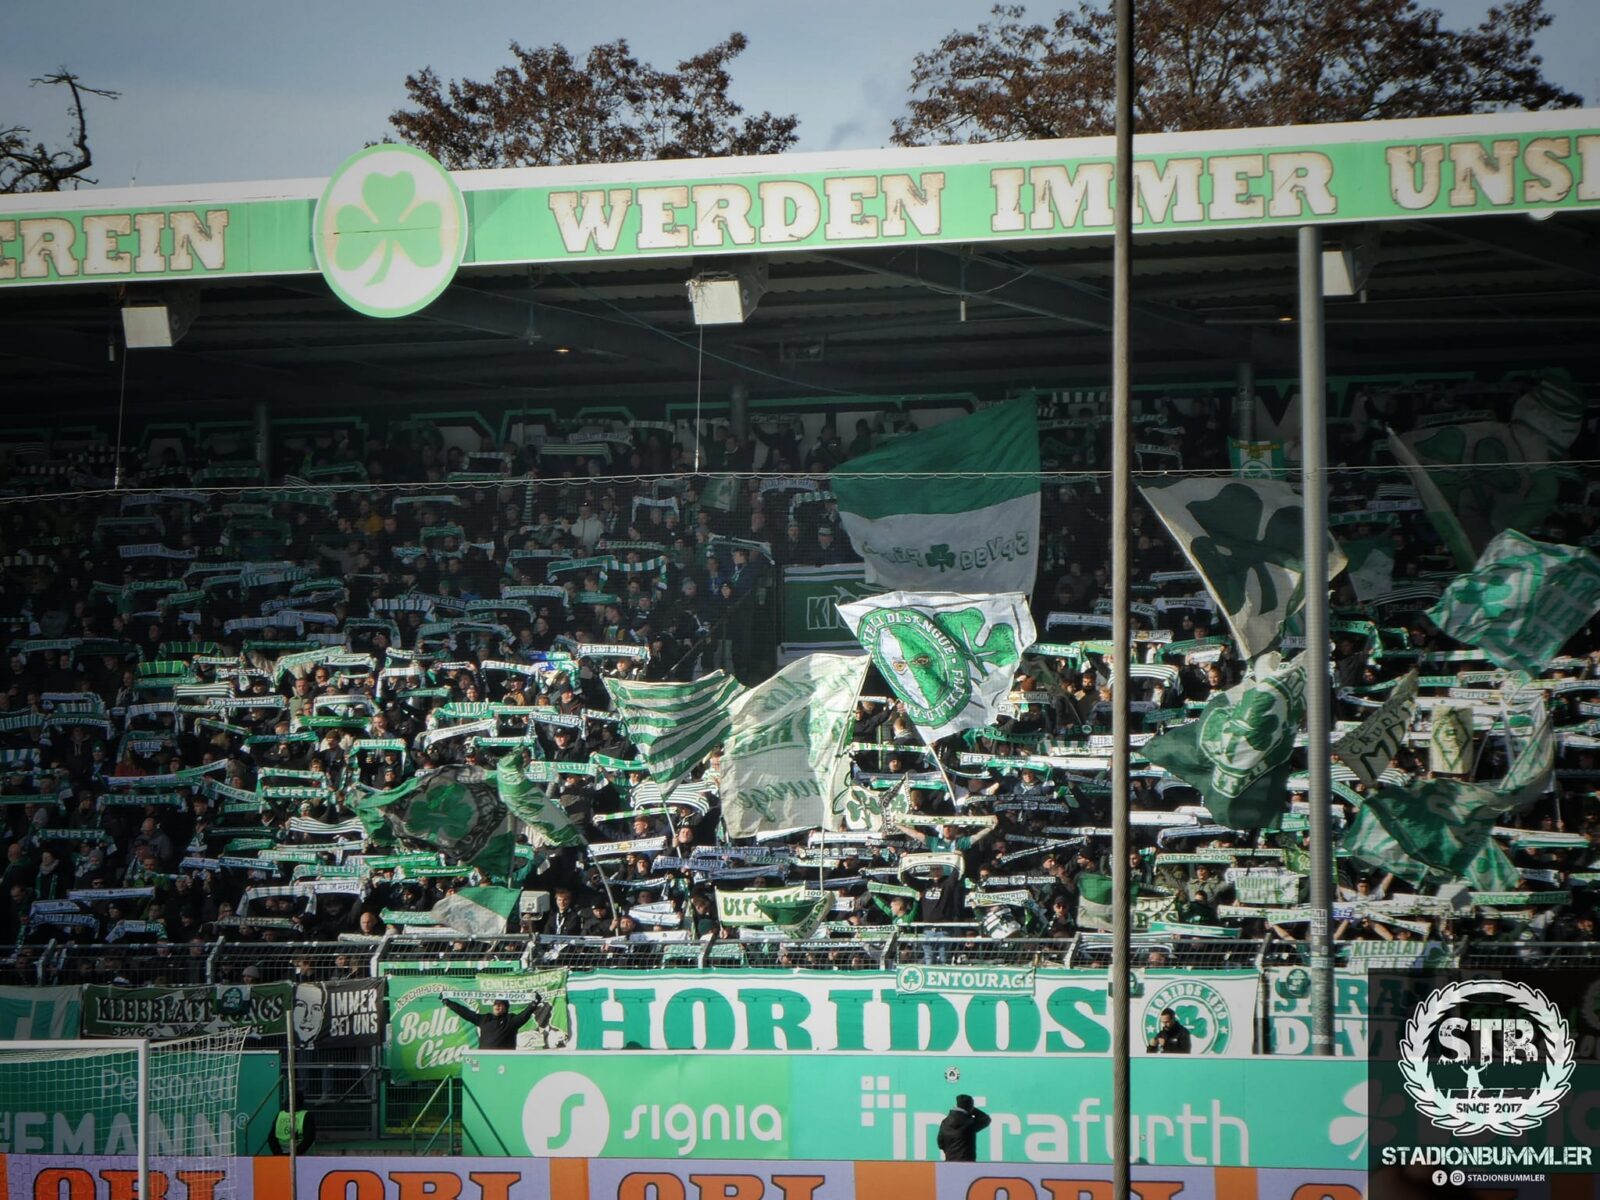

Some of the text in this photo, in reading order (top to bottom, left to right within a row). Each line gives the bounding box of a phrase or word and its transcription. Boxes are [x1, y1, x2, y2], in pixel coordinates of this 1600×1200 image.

[548, 171, 945, 253] WERDEN
[991, 151, 1338, 232] IMMER
[330, 988, 377, 1017] IMMER
[927, 970, 1034, 989] ENTOURAGE
[353, 1012, 378, 1036] UNS
[397, 1006, 460, 1046] Bella
[566, 987, 1112, 1053] HORIDOS
[623, 1103, 783, 1157] signia
[892, 1092, 1251, 1166] inrafurth
